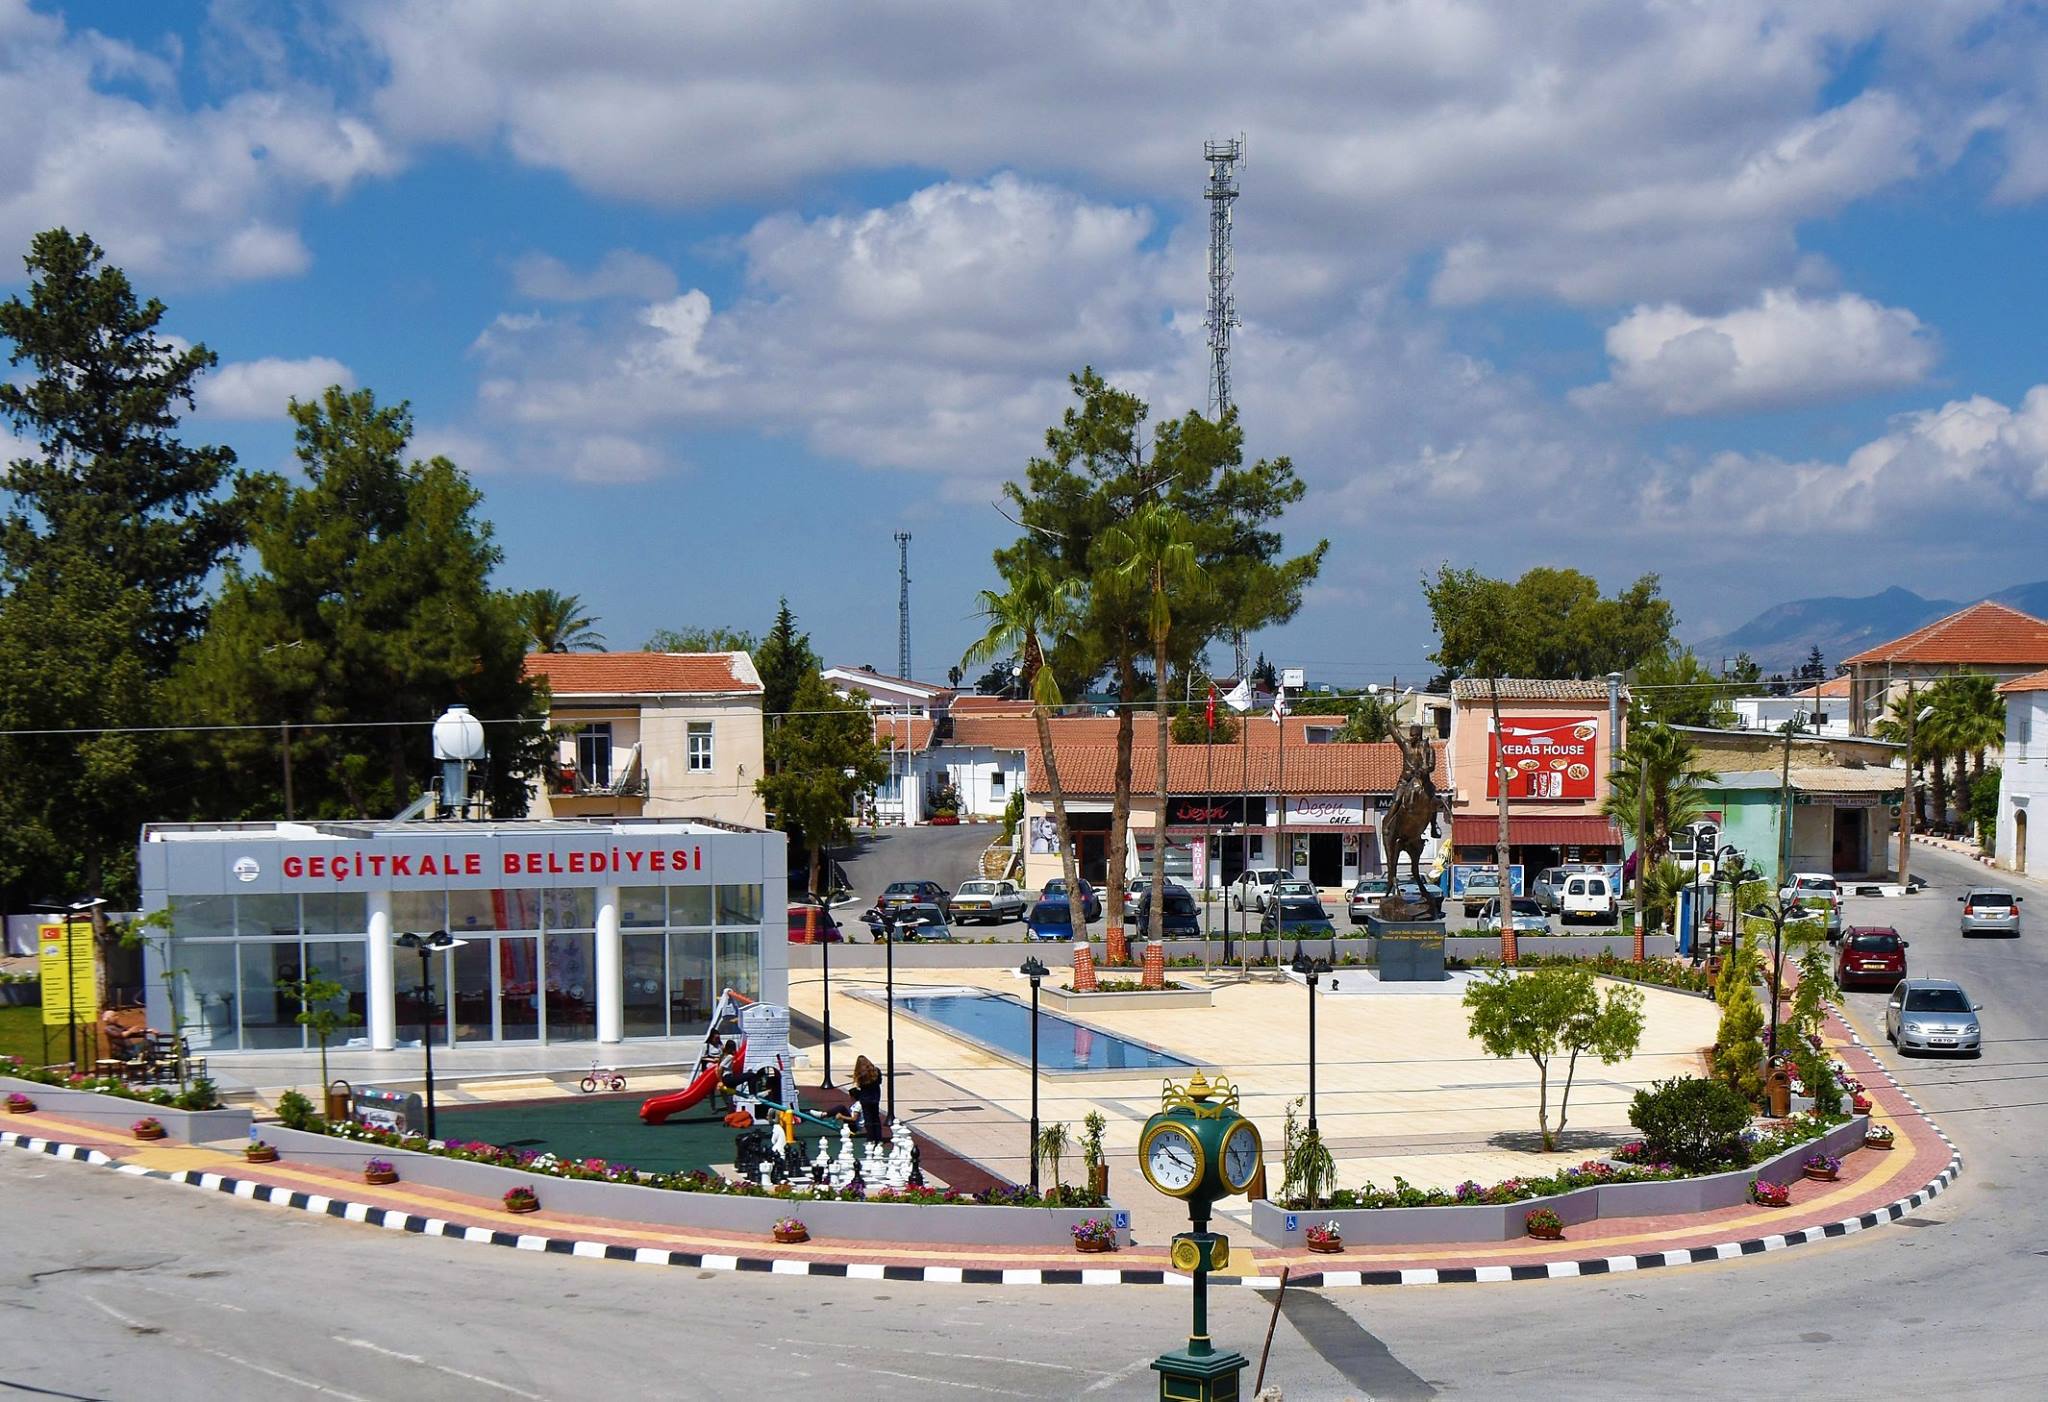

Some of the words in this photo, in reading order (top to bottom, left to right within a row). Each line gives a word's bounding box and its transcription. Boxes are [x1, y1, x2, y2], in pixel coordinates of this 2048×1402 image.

[1501, 745, 1540, 755] KEBAB
[1543, 745, 1584, 755] HOUSE
[1296, 797, 1346, 818] Desen
[1329, 816, 1352, 824] CAFE
[282, 851, 482, 882] GEÇİTKALE
[503, 846, 702, 874] BELEDİYESİ
